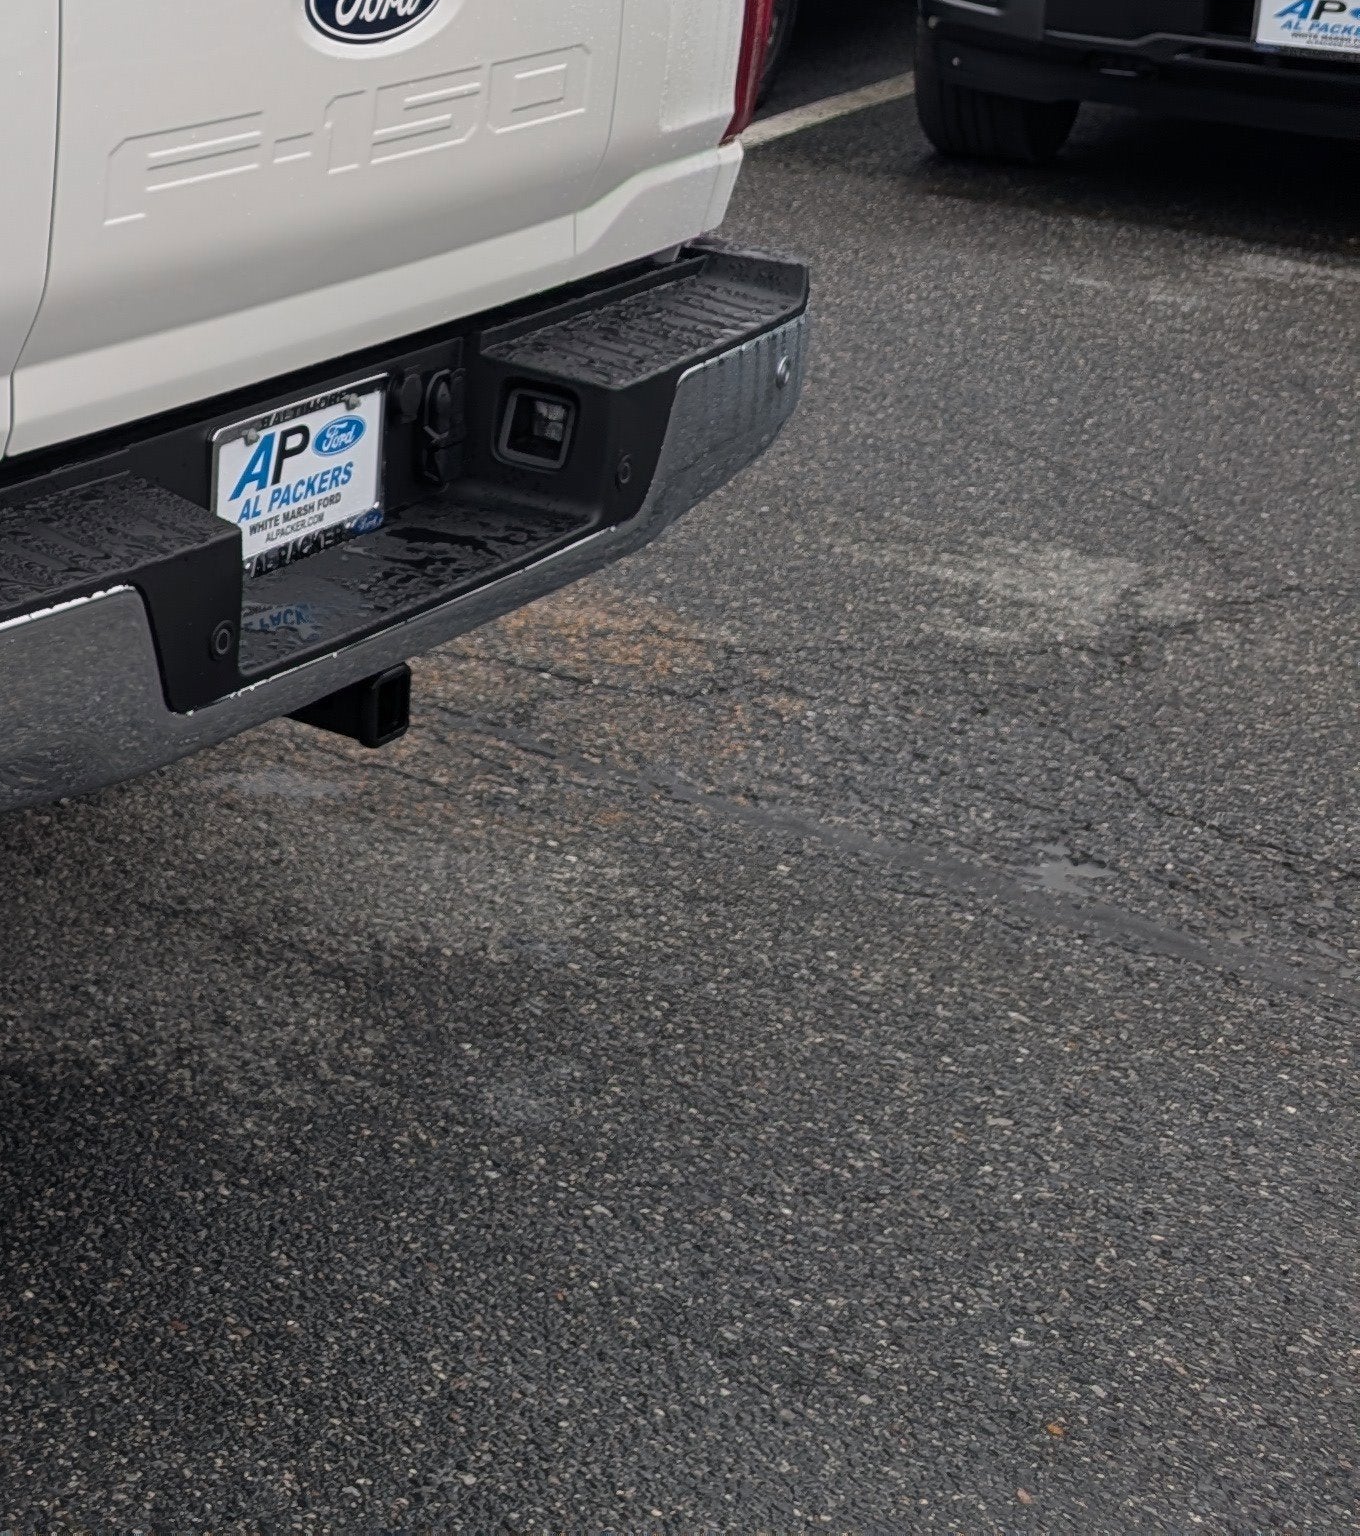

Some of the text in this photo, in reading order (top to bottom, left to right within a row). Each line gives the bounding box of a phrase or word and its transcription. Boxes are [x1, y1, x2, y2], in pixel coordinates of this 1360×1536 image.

[1281, 20, 1301, 31] AL
[103, 42, 592, 226] F-150
[228, 419, 358, 501] AP Ford
[237, 461, 354, 523] AL PACKERS
[249, 491, 342, 536] WHITE MARSH FORD
